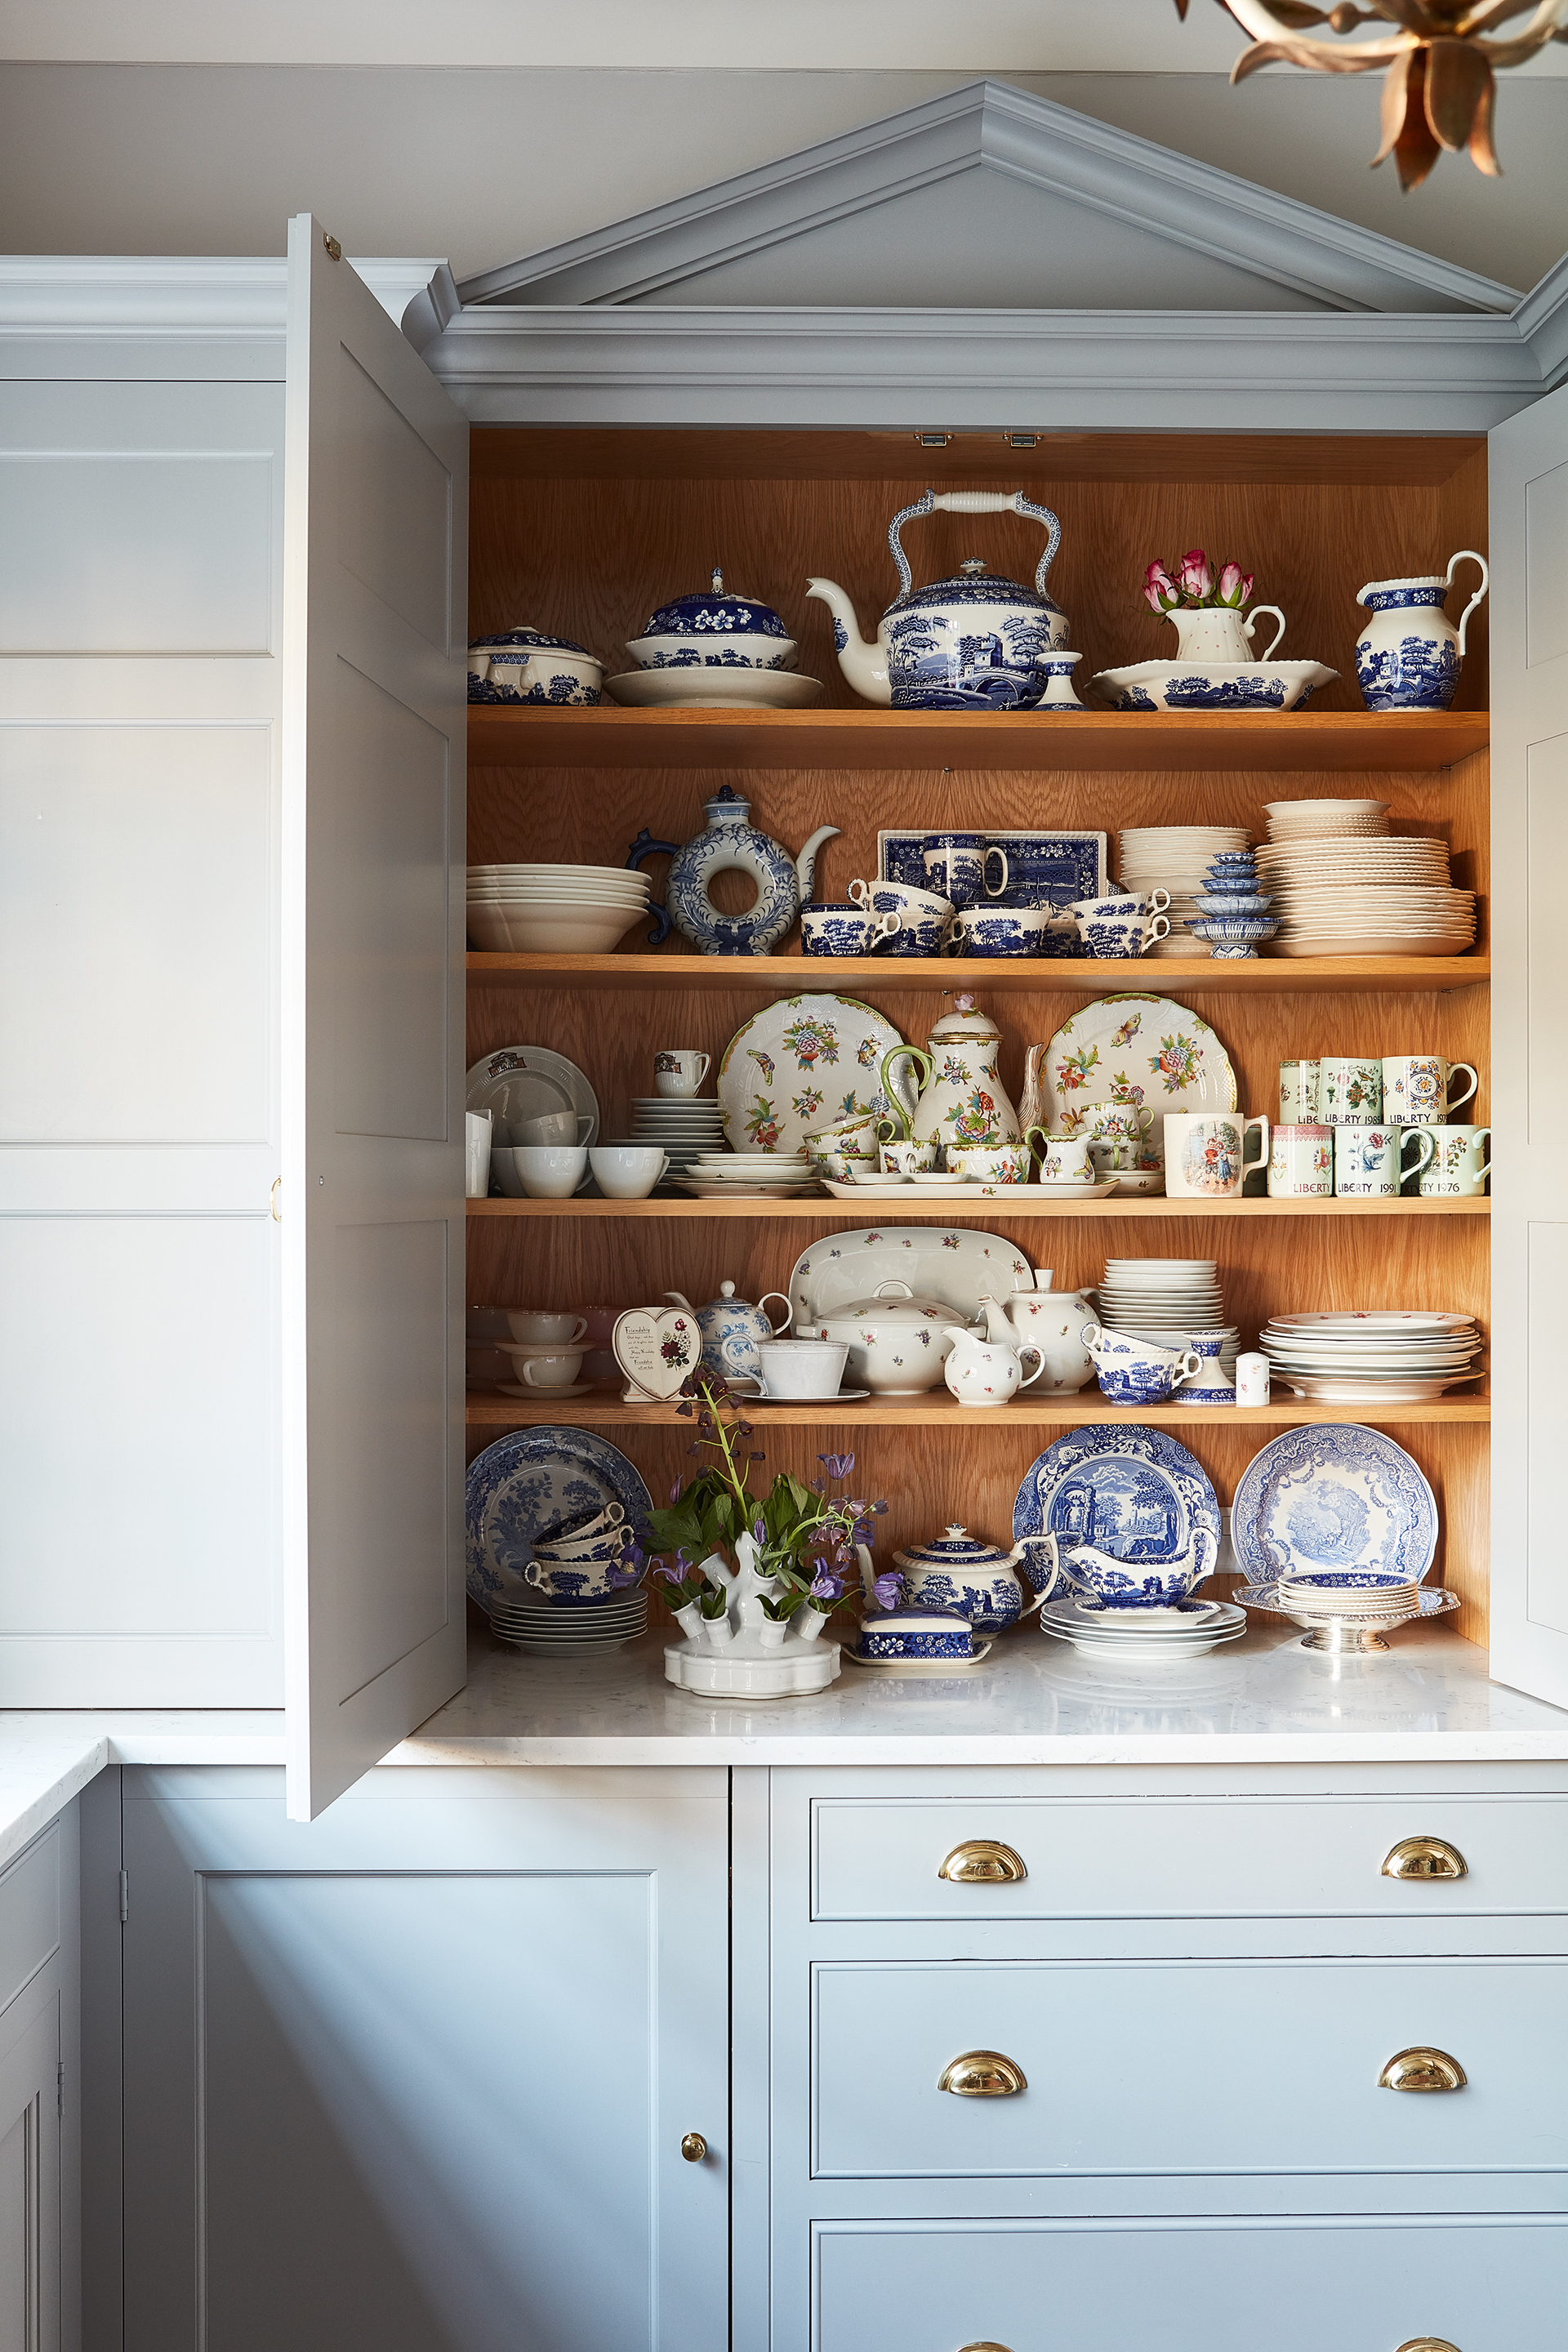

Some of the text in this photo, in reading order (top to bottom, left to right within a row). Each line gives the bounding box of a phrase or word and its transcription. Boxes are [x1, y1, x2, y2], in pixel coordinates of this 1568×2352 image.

[1325, 1113, 1380, 1125] LIBERTY 1985
[1389, 1113, 1431, 1124] LIBERTY
[1294, 1183, 1330, 1193] LIBERTY
[1338, 1183, 1396, 1193] LIBERTY 1991
[1437, 1183, 1460, 1192] 1976
[625, 1325, 651, 1334] Friendship
